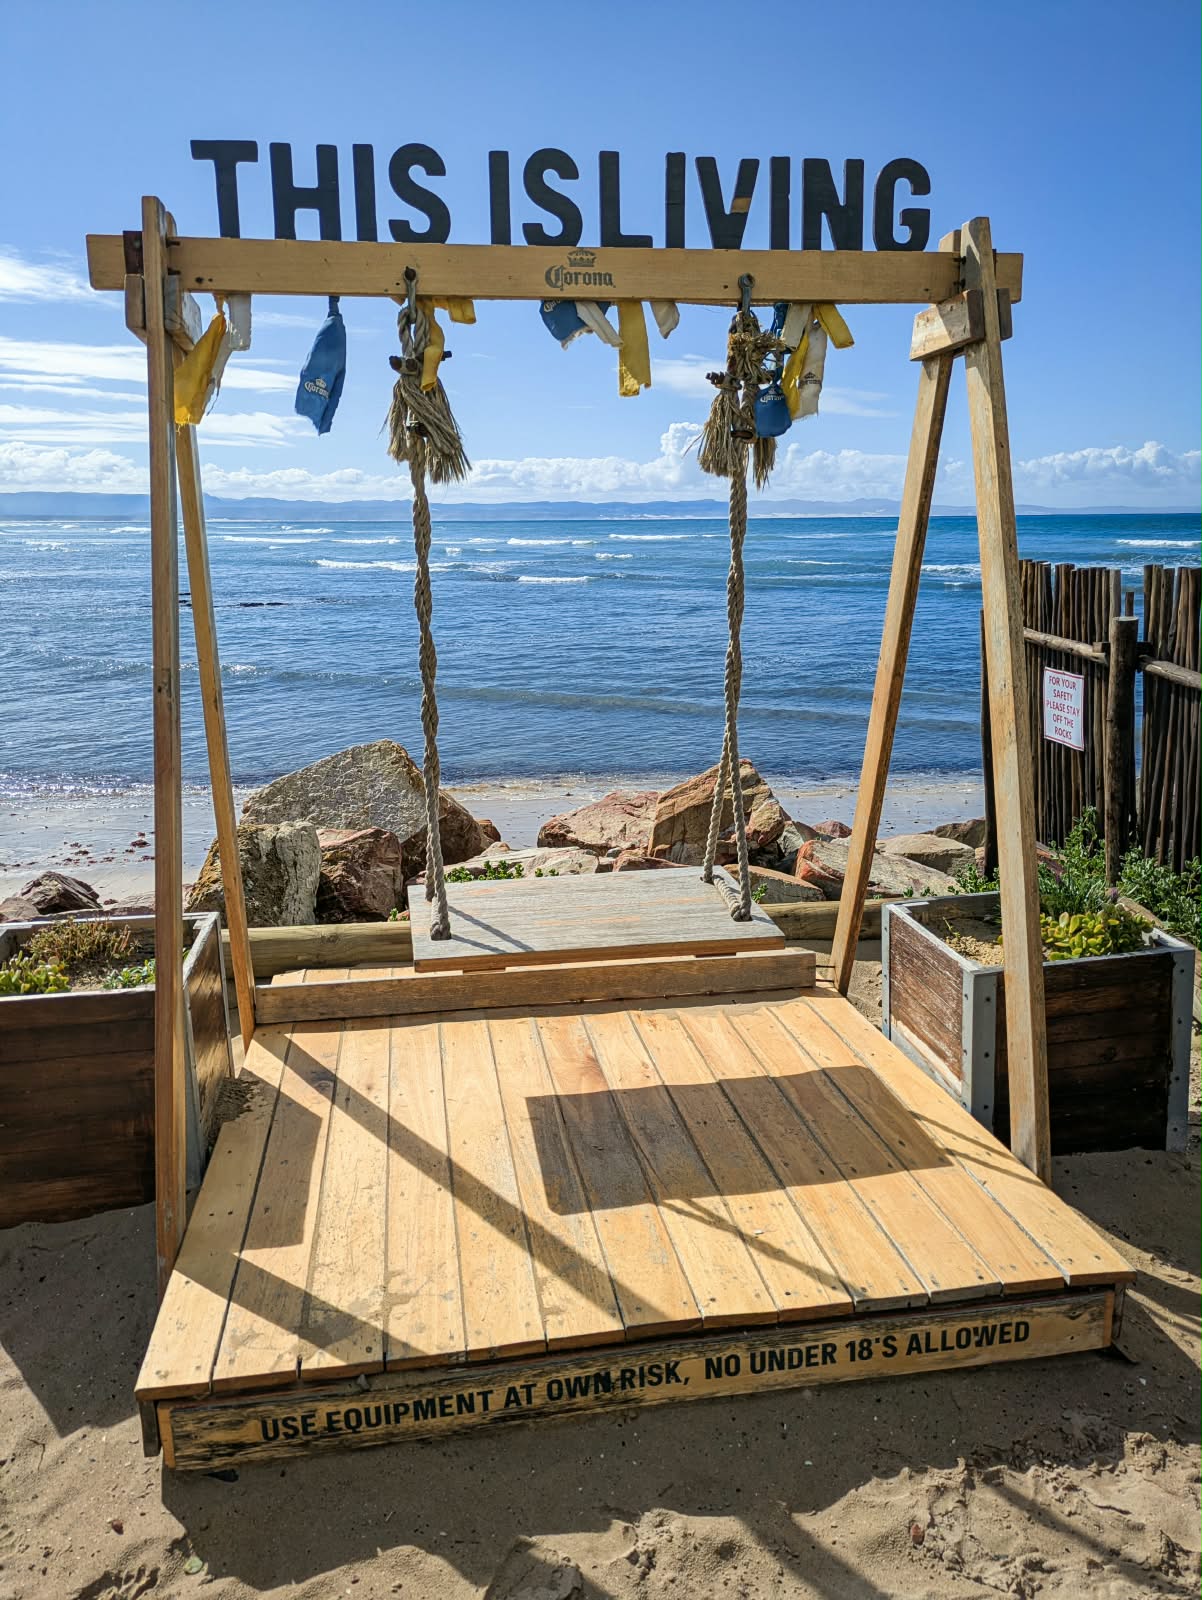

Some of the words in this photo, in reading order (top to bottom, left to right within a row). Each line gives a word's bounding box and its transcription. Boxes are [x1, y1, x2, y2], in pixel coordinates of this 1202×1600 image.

[190, 139, 451, 244] THIS
[545, 265, 616, 291] Corona
[1048, 675, 1061, 687] FOR
[1061, 678, 1077, 691] YOUR
[1053, 688, 1073, 702] SAFETY
[1046, 699, 1066, 713] PLEASE
[1066, 704, 1080, 718] STAY
[1052, 713, 1063, 724] OFF
[1063, 716, 1074, 729] THE
[1054, 726, 1072, 740] ROCKS
[260, 1413, 318, 1441] USE
[325, 1391, 494, 1433] EQUIPMENT
[503, 1383, 538, 1409] AT
[546, 1371, 612, 1402] OWN
[620, 1360, 690, 1391] RISK,
[704, 1353, 741, 1380] NO
[749, 1341, 838, 1375] UNDER
[845, 1334, 898, 1363] 18'S
[905, 1320, 1030, 1356] ALLOWED
